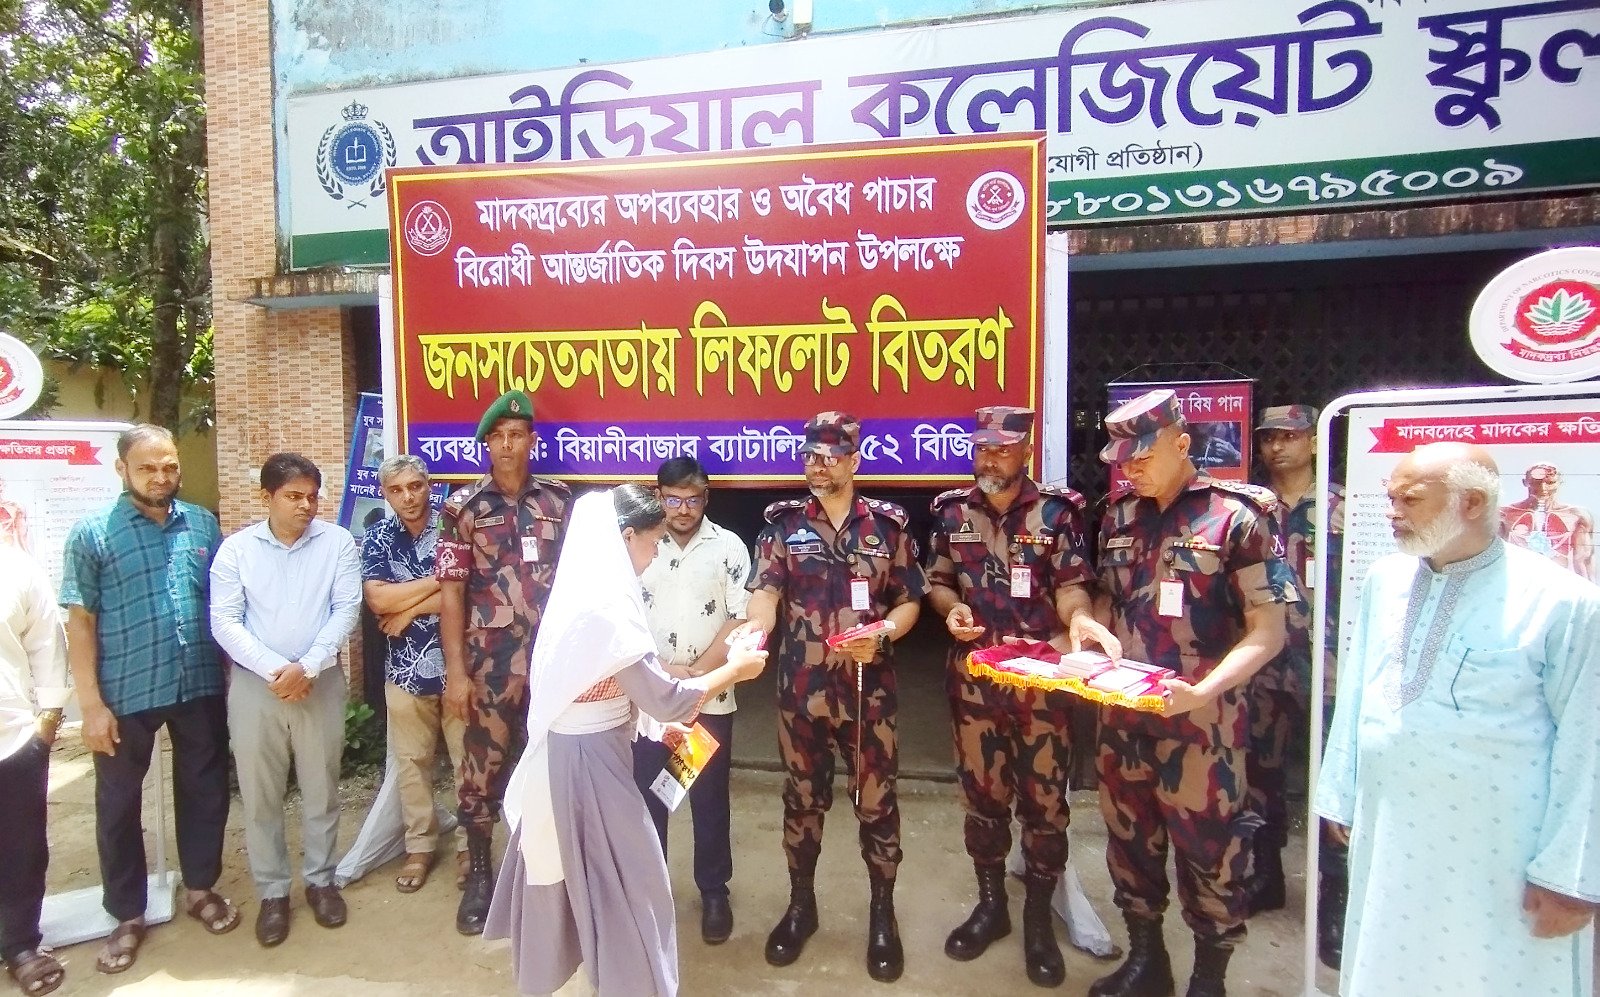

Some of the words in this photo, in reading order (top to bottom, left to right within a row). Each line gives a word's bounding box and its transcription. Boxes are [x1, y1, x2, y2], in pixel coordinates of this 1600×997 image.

[848, 0, 1384, 139] কলেজিয়েট
[1106, 139, 1203, 169] প্রতিষ্ঠান)
[475, 196, 608, 233] মাদকদ্রব্যের
[614, 185, 743, 225] অপব্যবহার
[750, 187, 771, 217] ও
[779, 173, 855, 217] অবৈধ
[862, 174, 937, 214] পাচার
[454, 242, 536, 288] বিরোধী
[540, 239, 667, 286] আন্তর্জাতিক
[671, 237, 737, 282] দিবস
[743, 234, 849, 277] উদযাপন
[855, 229, 965, 272] উপলক্ষে
[417, 320, 682, 400] জনসচেতনতায়
[689, 297, 858, 396] লিফলেট
[865, 294, 1014, 394] বিতরণ
[1188, 391, 1214, 412] বিষ
[1218, 394, 1244, 412] পান
[364, 415, 376, 428] যুব
[1397, 424, 1476, 440] মানবদেহে
[1480, 421, 1552, 438] মাদকের
[1556, 416, 1600, 436] ক্ষতি
[45, 445, 77, 457] প্রভাব
[554, 425, 701, 463] বিয়ানীবাজার
[707, 425, 806, 462] ব্যাটালি
[911, 423, 975, 461] বিজি
[356, 469, 369, 481] যুব
[350, 484, 376, 497] মানেই
